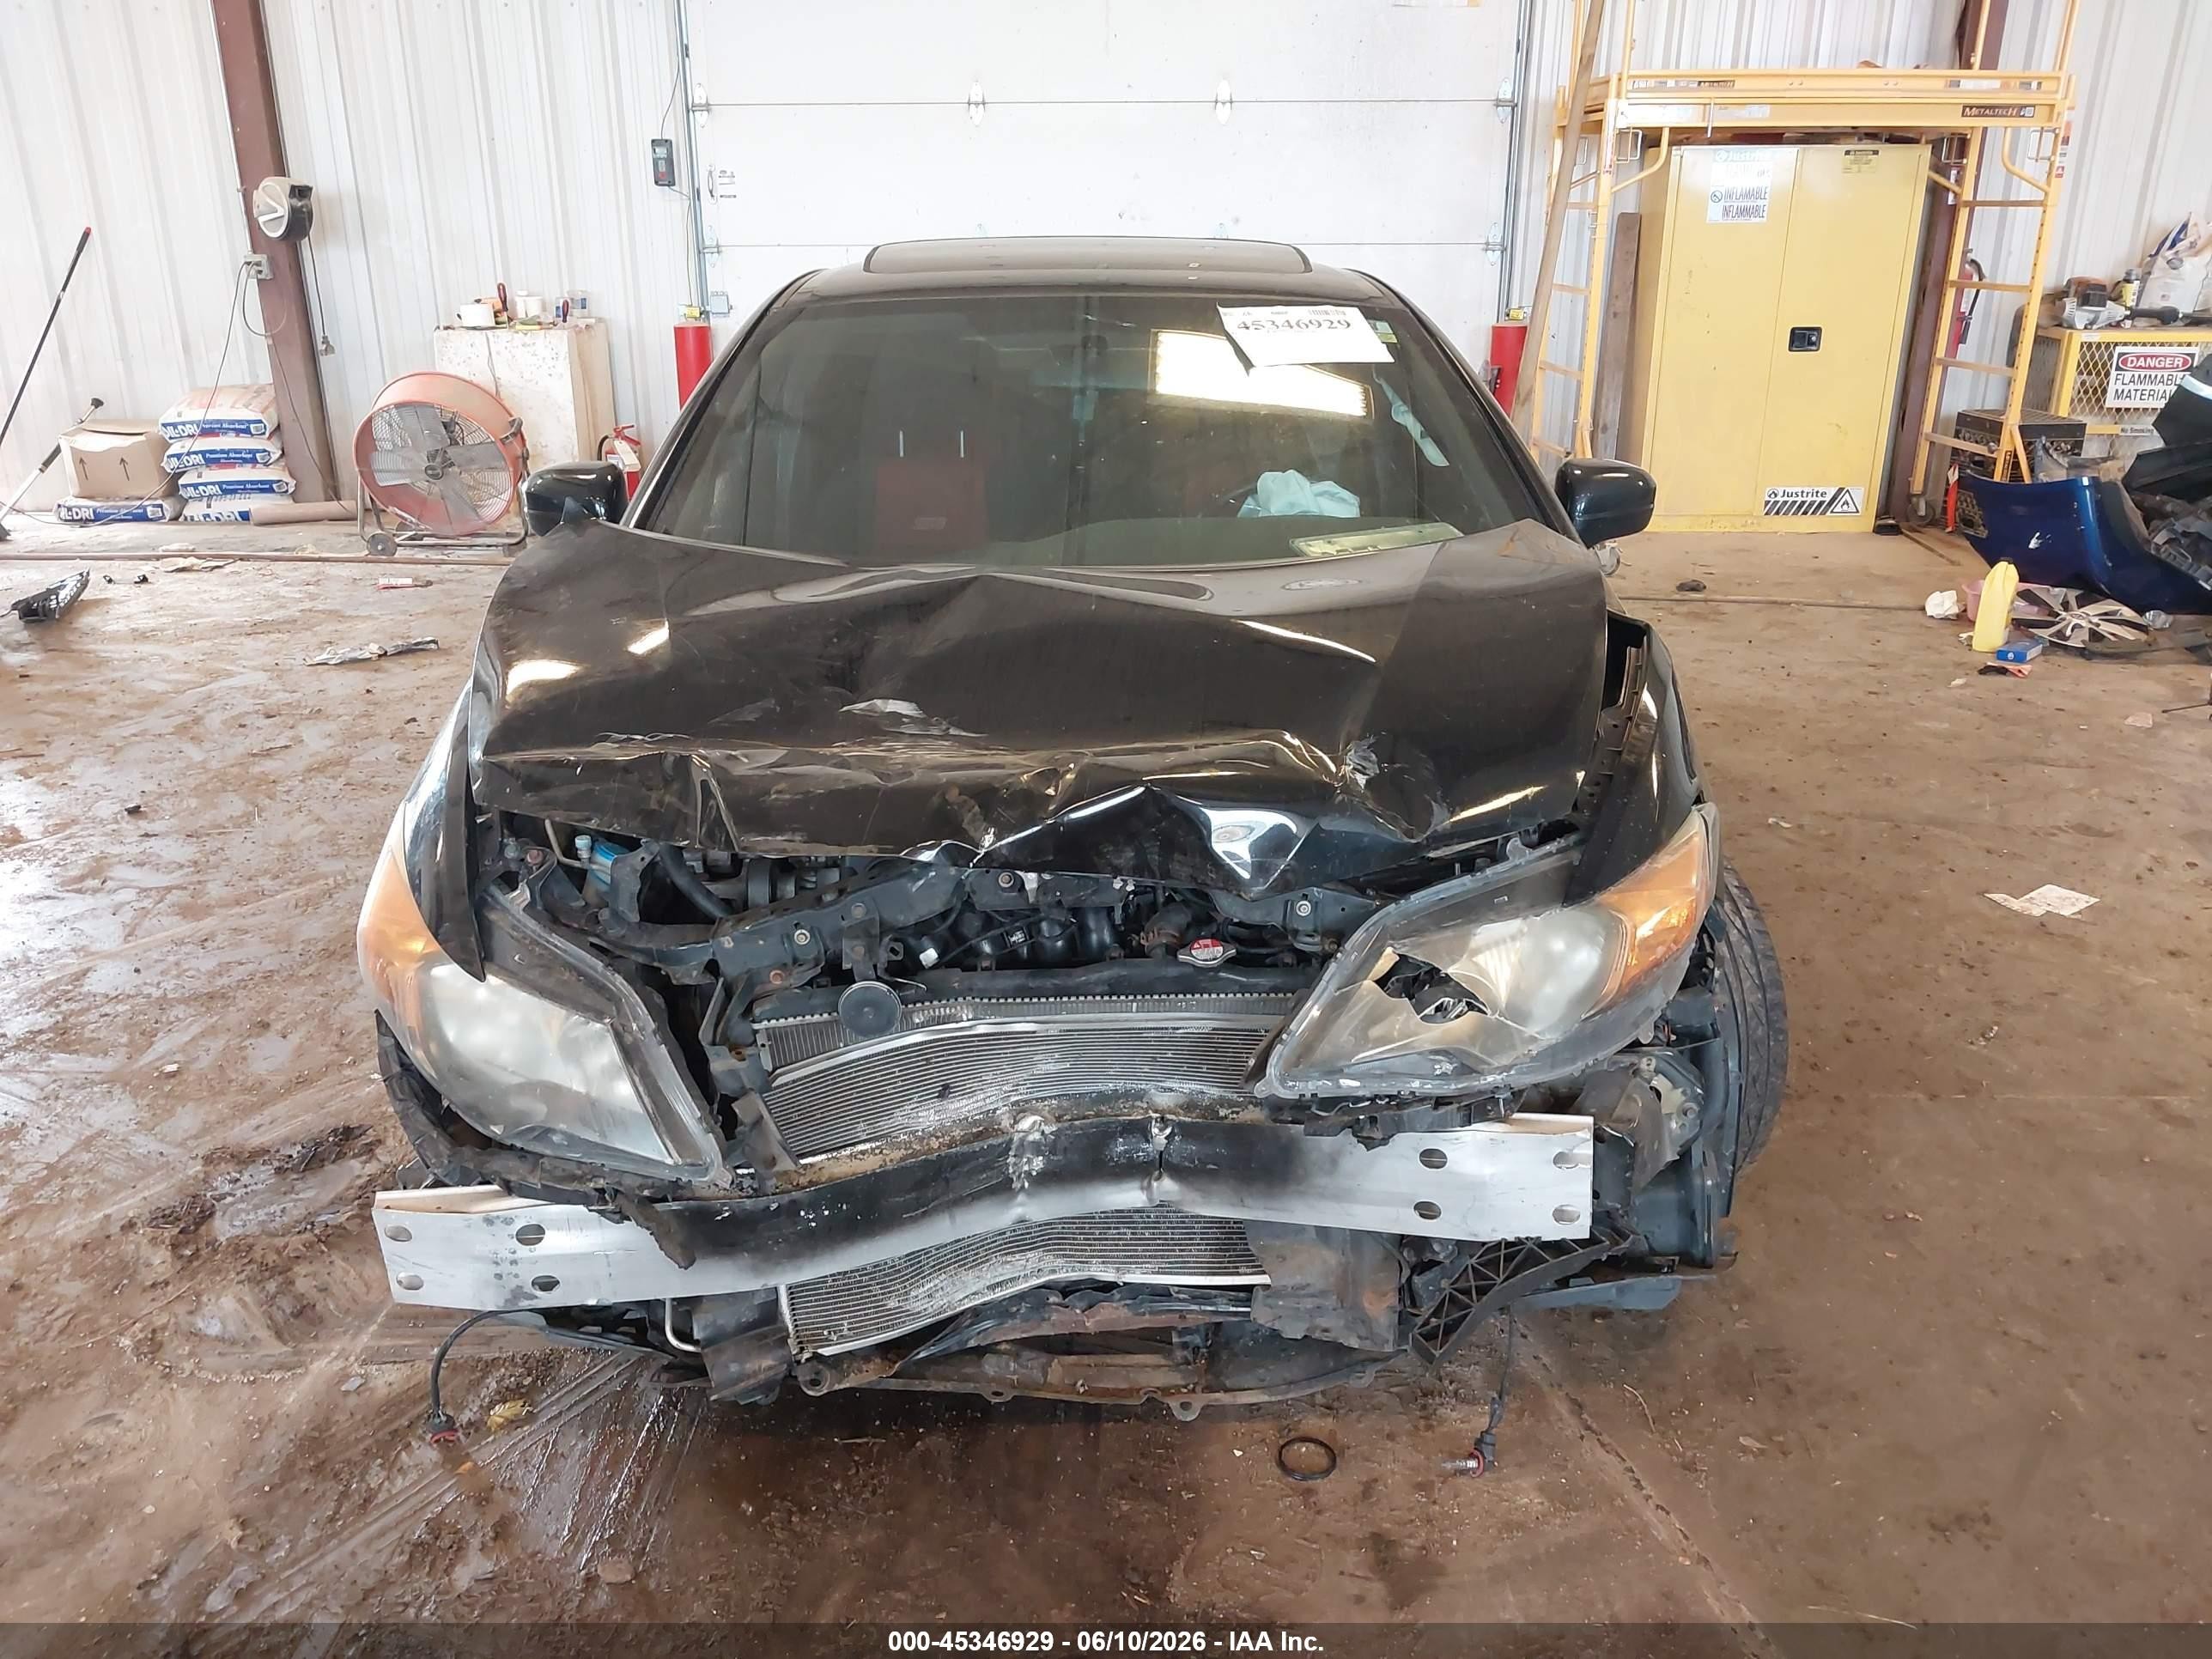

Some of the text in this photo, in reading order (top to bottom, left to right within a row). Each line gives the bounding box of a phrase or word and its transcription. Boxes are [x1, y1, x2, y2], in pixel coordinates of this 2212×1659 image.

[1723, 186, 1769, 200] INFLAMABLE
[1721, 204, 1766, 219] INFLAMMABLE
[1237, 319, 1352, 331] 45346929
[2126, 356, 2185, 369] DANGER
[2113, 373, 2184, 387] FLAMMABL
[1780, 489, 1827, 498] Justrite
